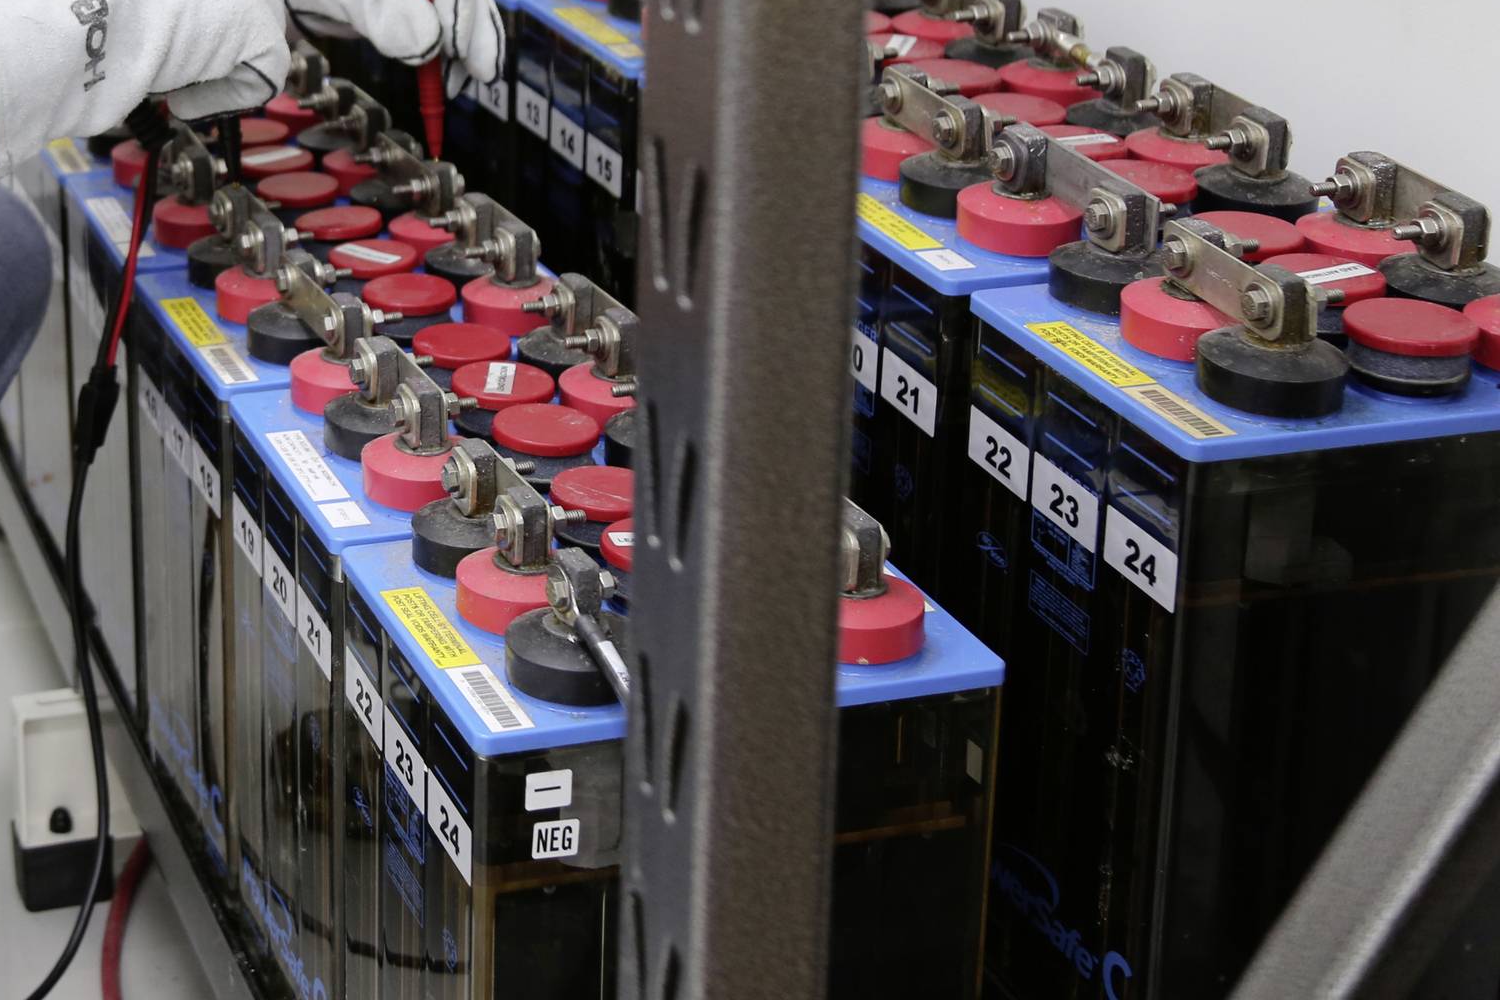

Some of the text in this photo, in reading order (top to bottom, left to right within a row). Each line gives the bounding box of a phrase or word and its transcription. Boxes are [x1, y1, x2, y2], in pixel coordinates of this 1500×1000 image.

[526, 102, 540, 126] 13
[560, 128, 575, 156] 14
[597, 153, 613, 182] 15
[853, 343, 864, 373] 0
[896, 373, 920, 415] 21
[171, 426, 185, 452] 17
[985, 435, 1012, 480] 22
[199, 464, 213, 499] 18
[1049, 483, 1080, 528] 23
[241, 519, 255, 554] 19
[1124, 537, 1157, 587] 24
[272, 565, 288, 604] 20
[412, 592, 433, 610] LIFTING
[307, 614, 322, 655] 21
[391, 595, 407, 607] POST
[409, 619, 427, 633] VOIDS
[419, 633, 447, 659] WARRANTY
[401, 593, 420, 609] POSTS
[420, 617, 448, 645] TAMPERING
[355, 678, 373, 725] 22
[395, 739, 414, 787] 23
[440, 805, 461, 857] 24
[536, 825, 573, 854] NEG
